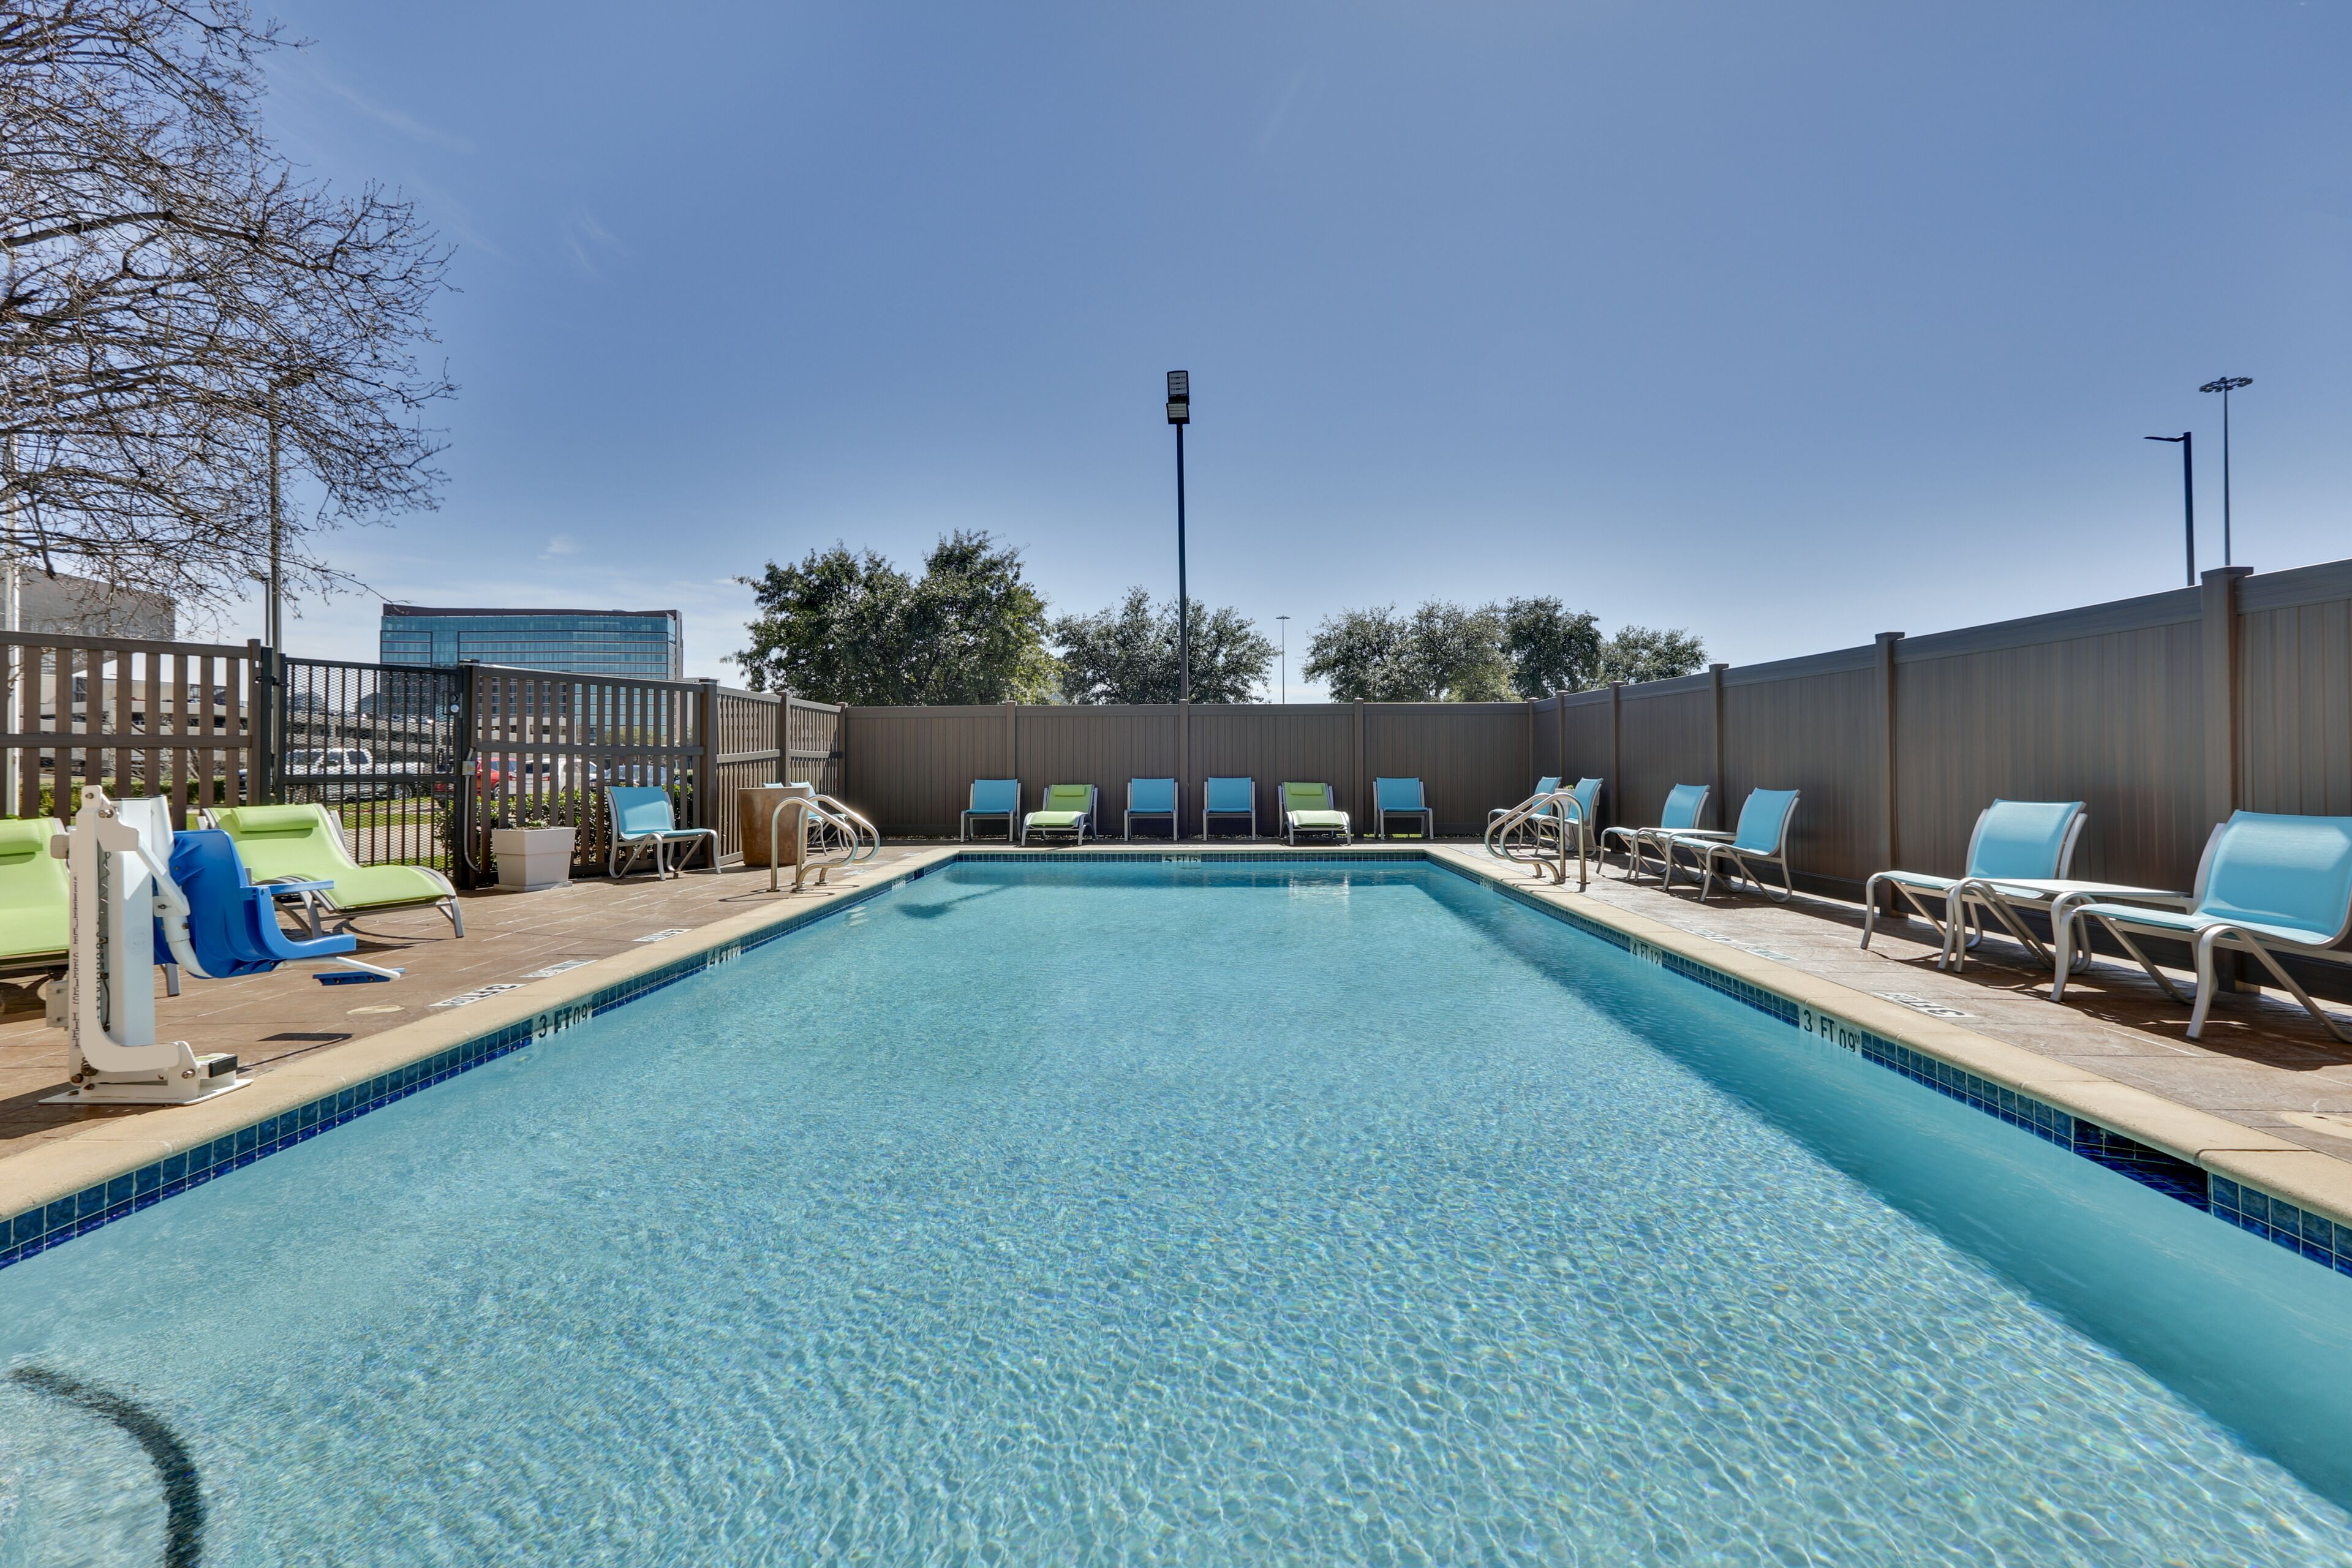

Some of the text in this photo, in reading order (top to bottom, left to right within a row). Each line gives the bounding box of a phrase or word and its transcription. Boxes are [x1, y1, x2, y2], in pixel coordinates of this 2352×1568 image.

[710, 949, 715, 965] 4
[719, 945, 729, 963] FT
[1632, 943, 1637, 956] 4
[1641, 943, 1648, 960] FT
[538, 1014, 547, 1038] 3
[554, 1006, 572, 1034] FT
[1804, 1009, 1812, 1032] 3
[1820, 1016, 1834, 1042] FT
